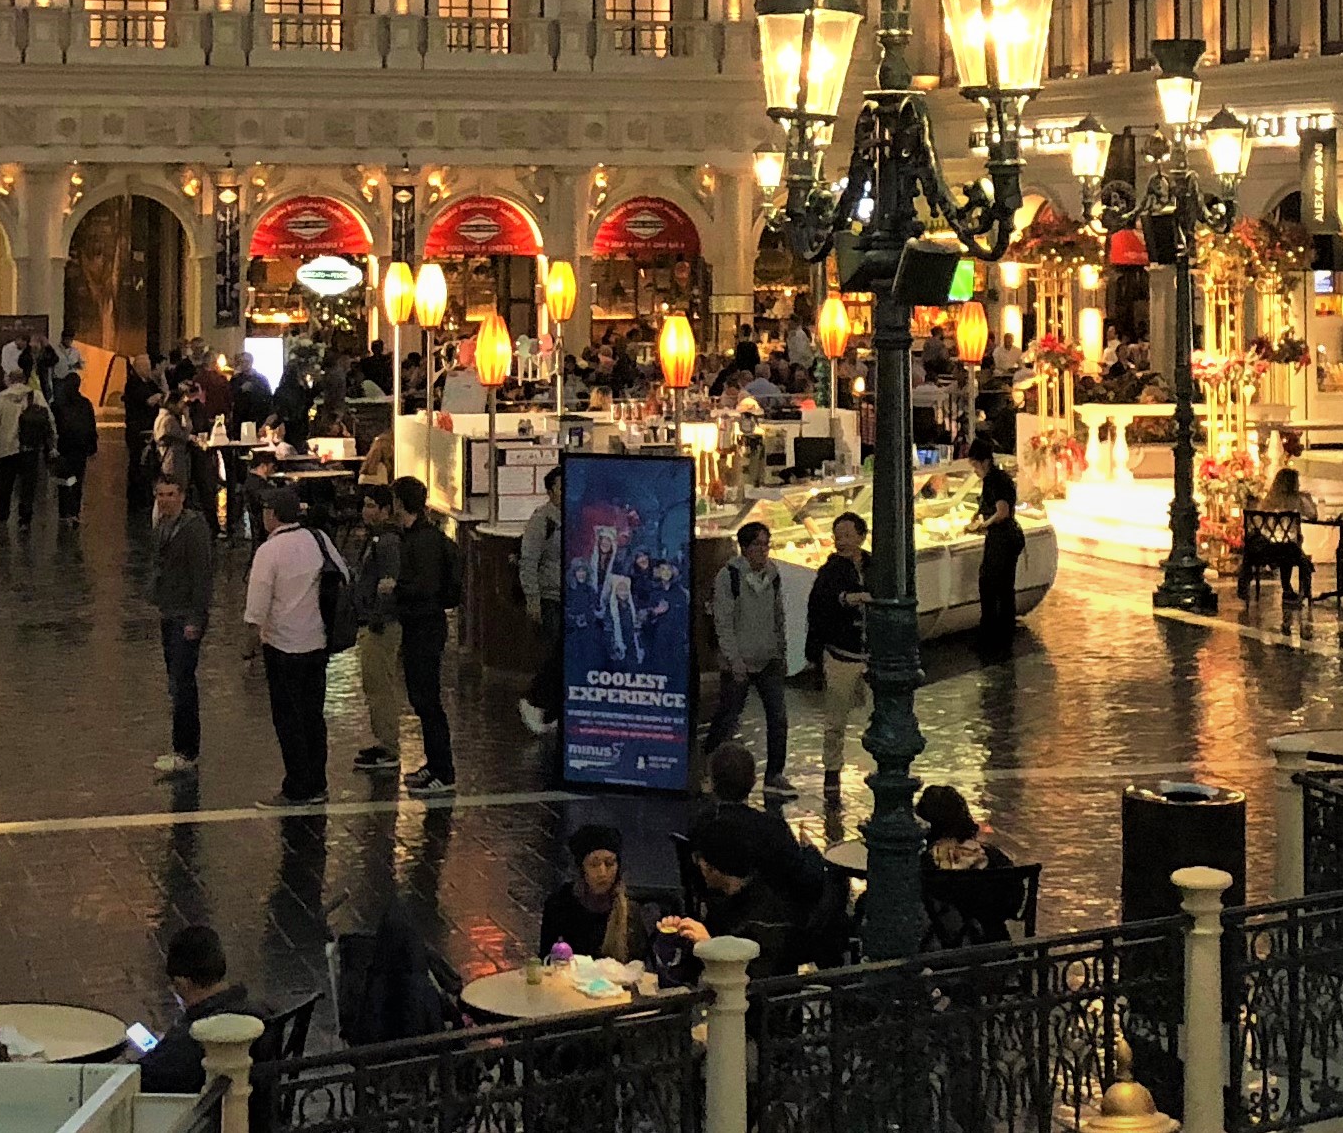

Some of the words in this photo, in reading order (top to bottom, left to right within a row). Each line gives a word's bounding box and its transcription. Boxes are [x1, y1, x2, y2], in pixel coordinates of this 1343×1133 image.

[1315, 193, 1324, 222] ALEX
[587, 670, 667, 689] COOLEST
[568, 686, 686, 708] EXPERIENCE
